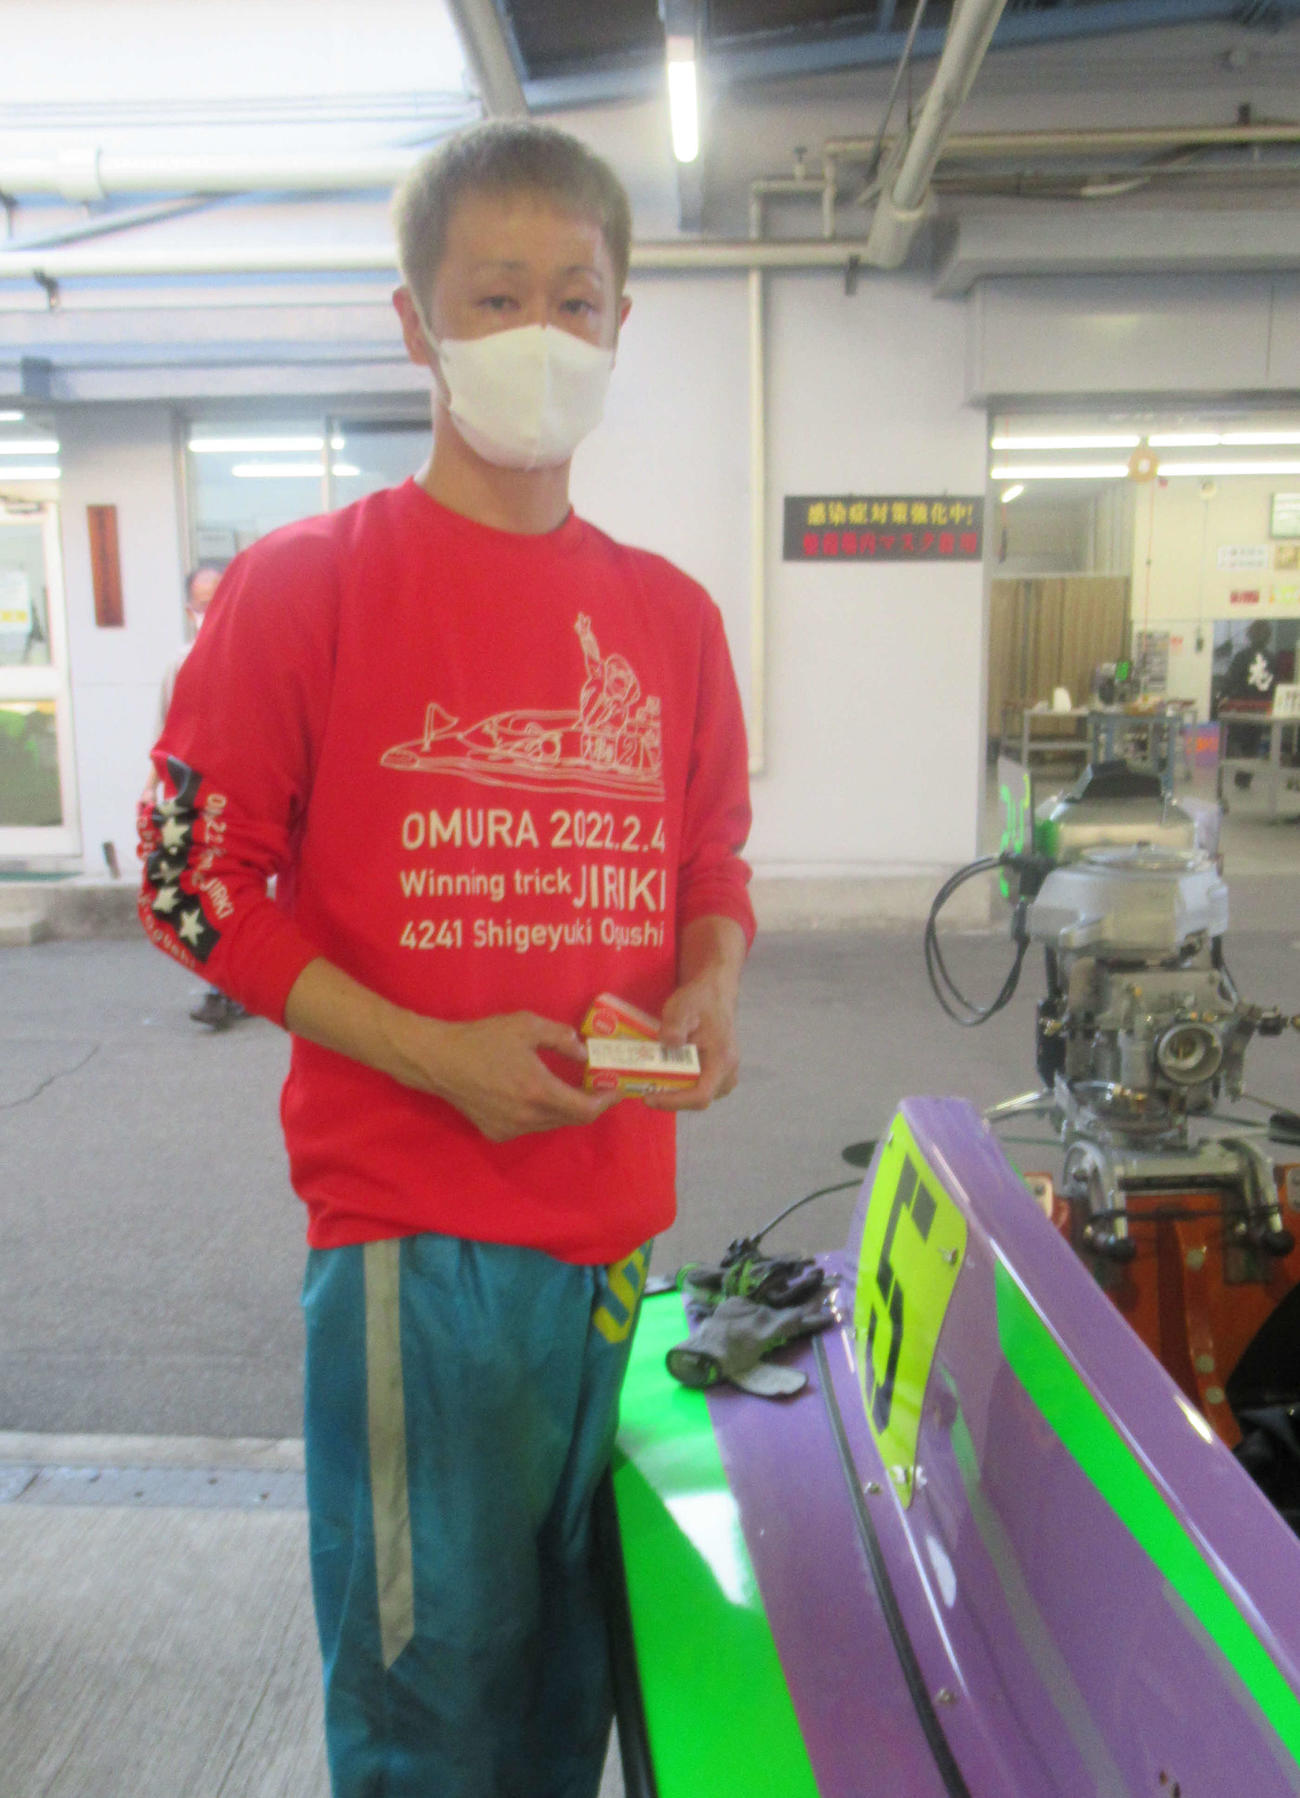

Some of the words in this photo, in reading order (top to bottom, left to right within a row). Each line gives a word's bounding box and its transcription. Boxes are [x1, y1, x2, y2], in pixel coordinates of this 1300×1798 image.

[402, 808, 540, 850] OMURA
[550, 809, 666, 853] 2022.2.4
[400, 868, 505, 902] Winning
[514, 868, 572, 895] trick
[572, 864, 666, 912] JIRIKI
[400, 919, 463, 949] 4241
[473, 918, 593, 954] Shigeyuki
